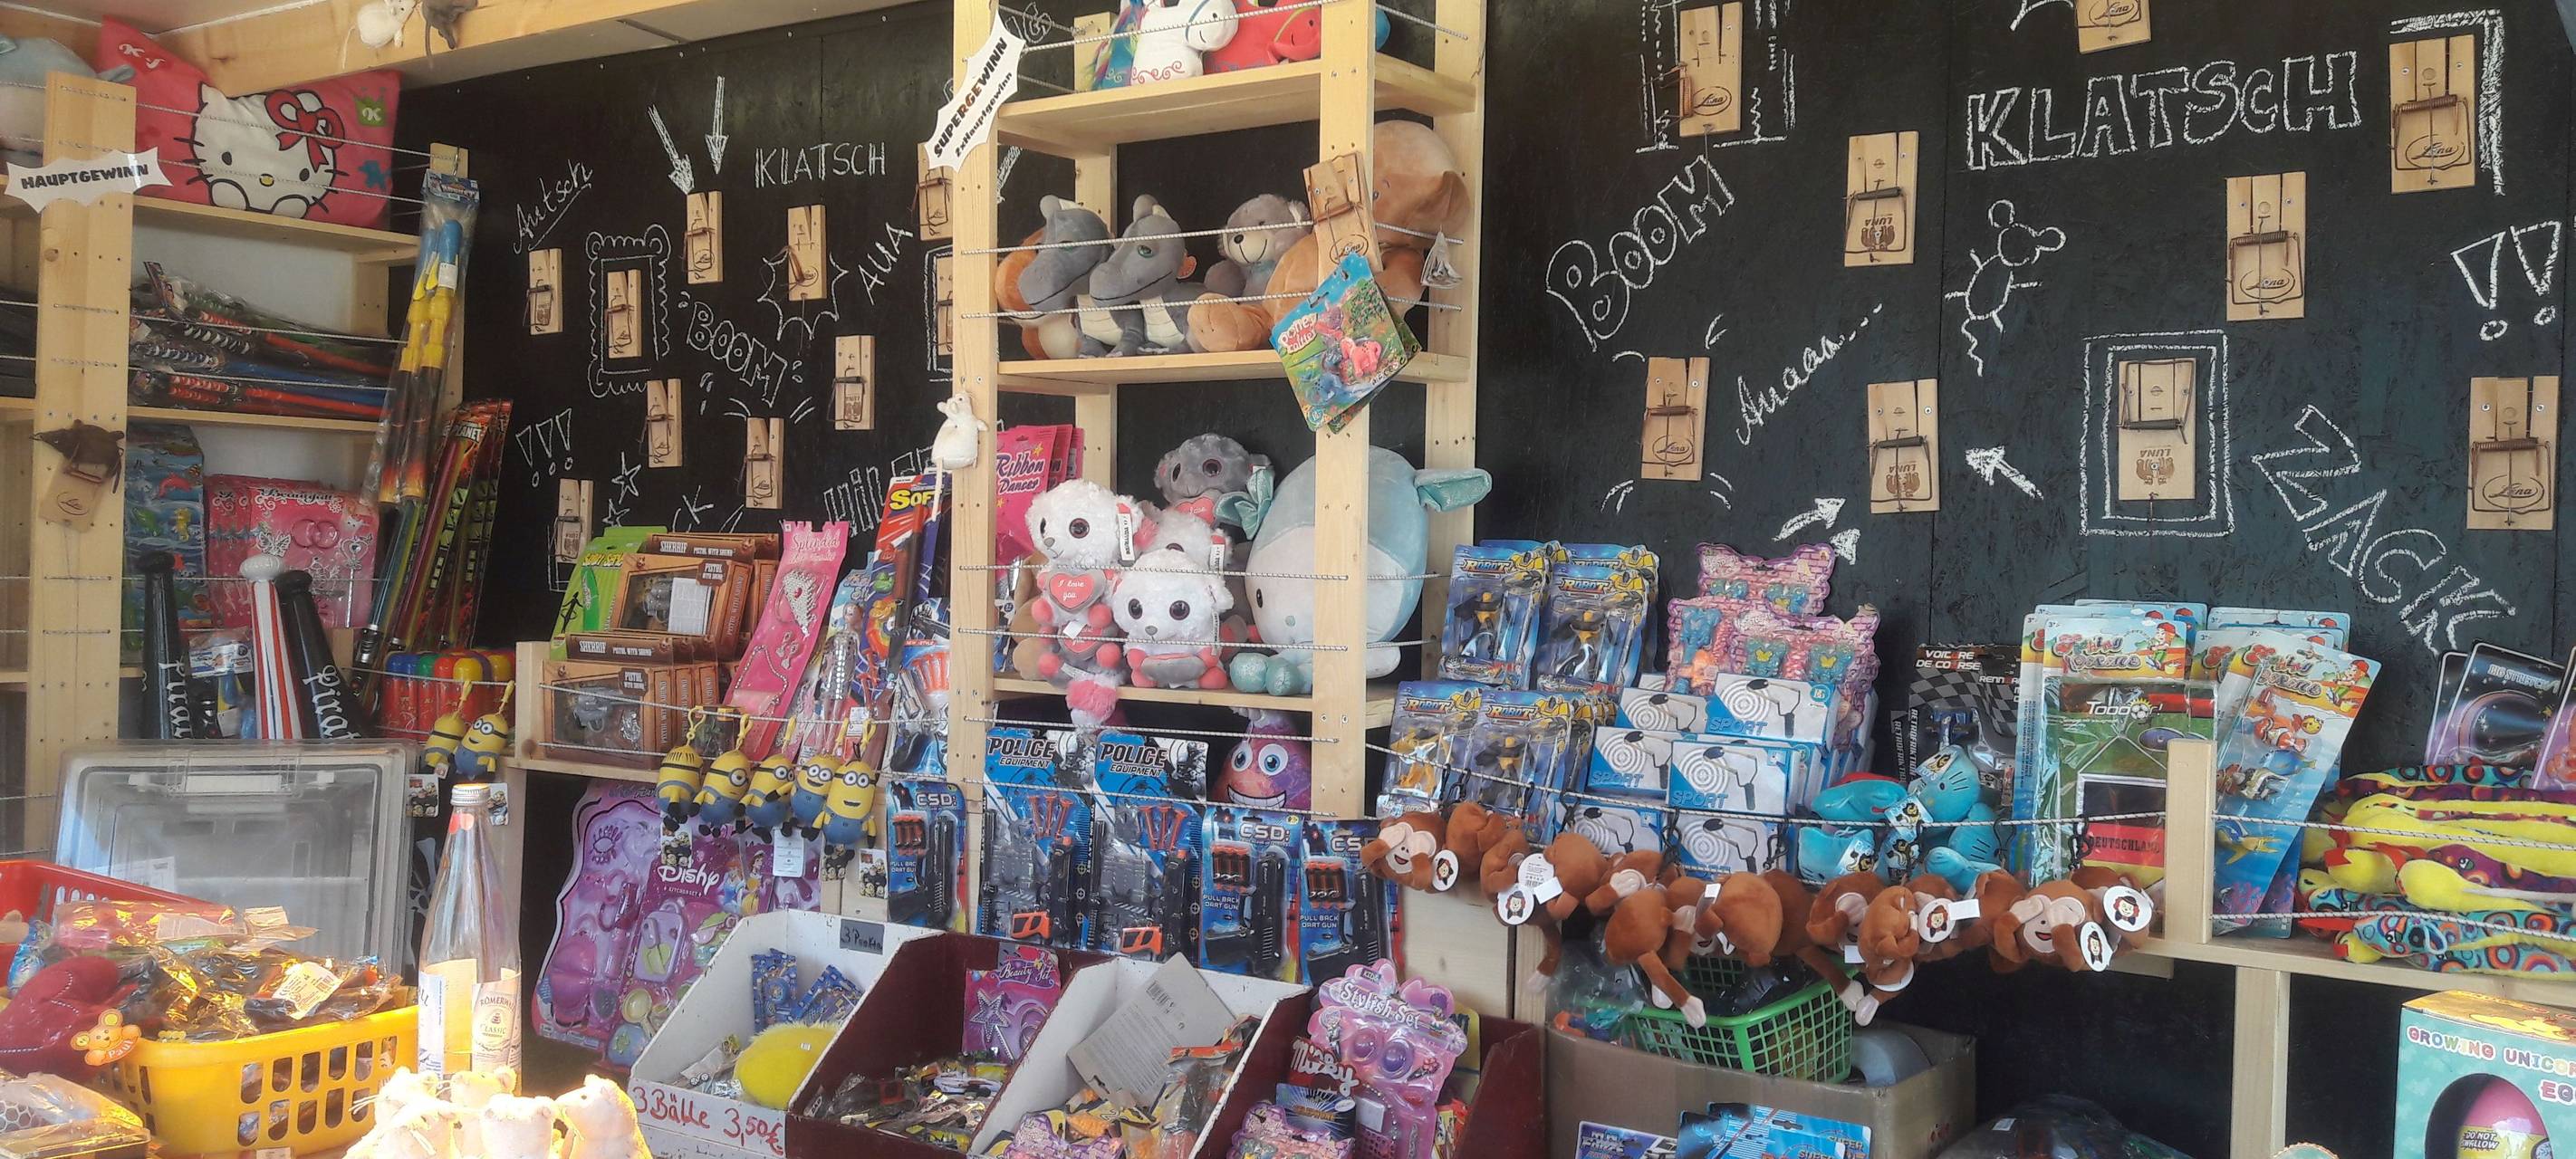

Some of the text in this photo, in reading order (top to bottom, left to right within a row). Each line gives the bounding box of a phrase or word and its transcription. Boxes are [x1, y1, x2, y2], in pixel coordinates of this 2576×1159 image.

[934, 37, 1007, 158] SUPERGEWINN
[955, 72, 1013, 158] 2xHauptgewinn
[1967, 51, 2361, 170] KLATSCH
[755, 142, 887, 187] KLATSCH
[21, 163, 149, 190] HAUPTGEWINN
[858, 222, 913, 305] AUA
[1546, 155, 1735, 352] BOOM
[687, 302, 787, 407] BOOM
[995, 452, 1044, 479] Ribbon
[998, 477, 1041, 495] Dancer
[889, 489, 942, 511] SOF
[2252, 404, 2516, 656] ZACK
[1465, 559, 1511, 574] ROBOT
[1562, 578, 1610, 593] ROBOT
[1916, 659, 1933, 668] DE
[1406, 698, 1451, 714] ROBOT
[1488, 704, 1538, 720] ROBOT
[1709, 716, 1768, 736] SPORT
[987, 737, 1057, 759] POLICE
[1101, 742, 1168, 767] POLICE
[999, 757, 1051, 769] EQUIPMENT
[1110, 764, 1163, 777] EQUIPMENT
[1672, 790, 1728, 808] SPORT
[1224, 902, 1239, 910] GUN
[999, 961, 1033, 984] Beauty
[1341, 979, 1420, 1030] Stylish Set
[109, 1039, 133, 1058] Paul
[2406, 1026, 2495, 1060] GROWING
[2540, 1080, 2576, 1106] EG
[632, 1087, 784, 1155] 3 Bälle 3,50€
[2464, 1131, 2497, 1142] DO NOT
